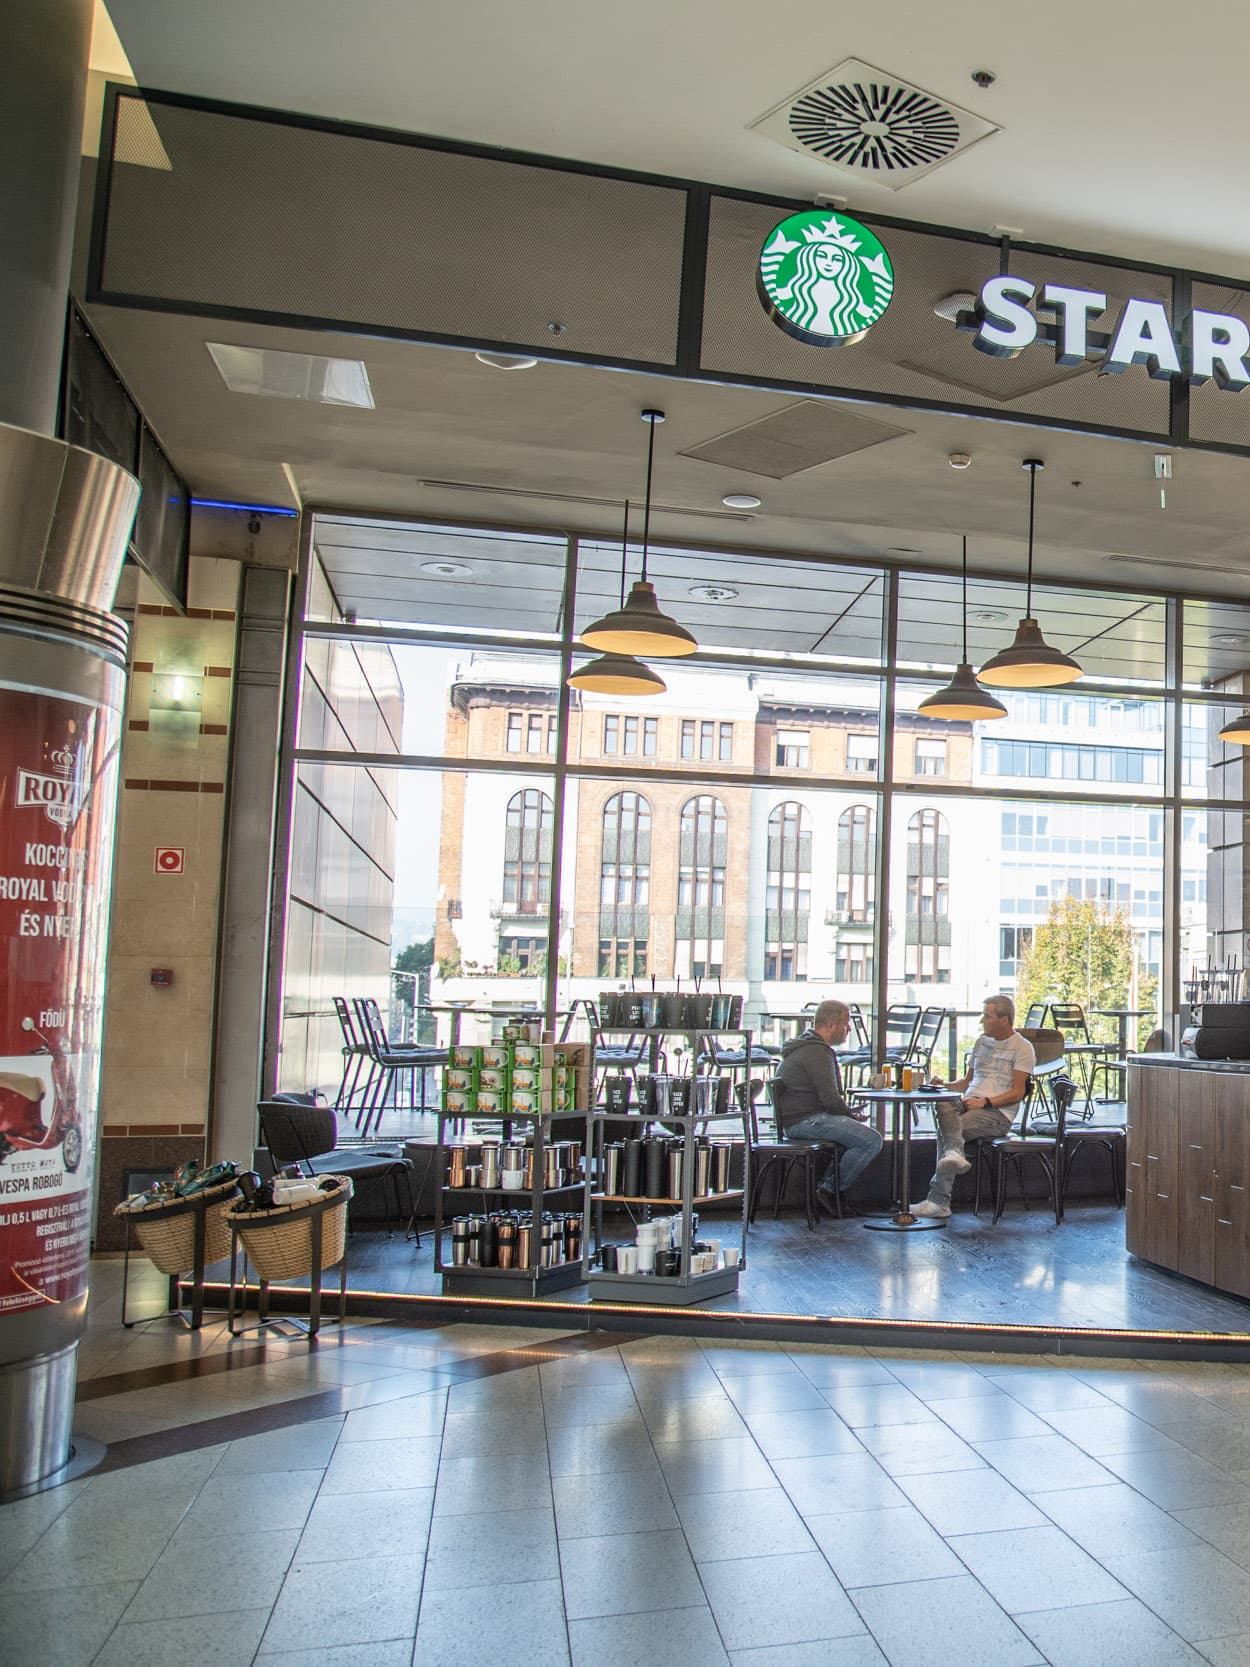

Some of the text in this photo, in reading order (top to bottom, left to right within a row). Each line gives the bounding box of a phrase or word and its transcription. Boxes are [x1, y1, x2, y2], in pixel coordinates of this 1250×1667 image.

[0, 877, 48, 902] ROYAL
[20, 909, 40, 936] ÉS
[0, 1171, 63, 1194] VESPA ROBOGÓ
